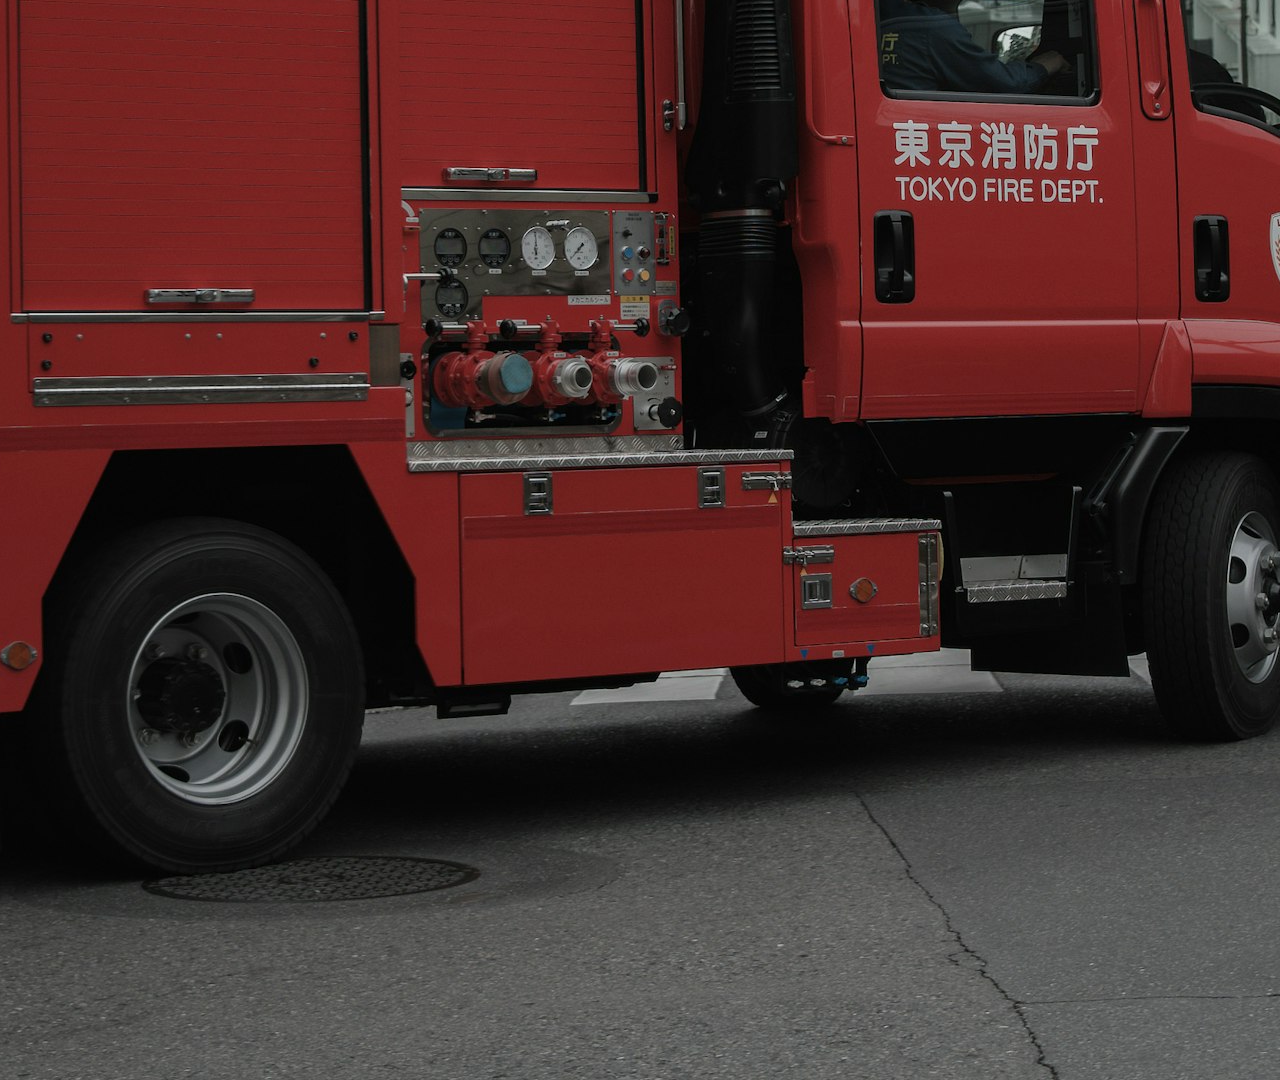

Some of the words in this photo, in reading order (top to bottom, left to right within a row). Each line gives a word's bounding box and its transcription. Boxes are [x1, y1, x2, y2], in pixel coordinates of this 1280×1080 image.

[893, 120, 1099, 170] 東京消防庁
[895, 176, 977, 201] TOKYO
[983, 178, 1034, 202] FIRE
[1041, 179, 1104, 203] DEPT.
[570, 296, 609, 304] メカニカルシール
